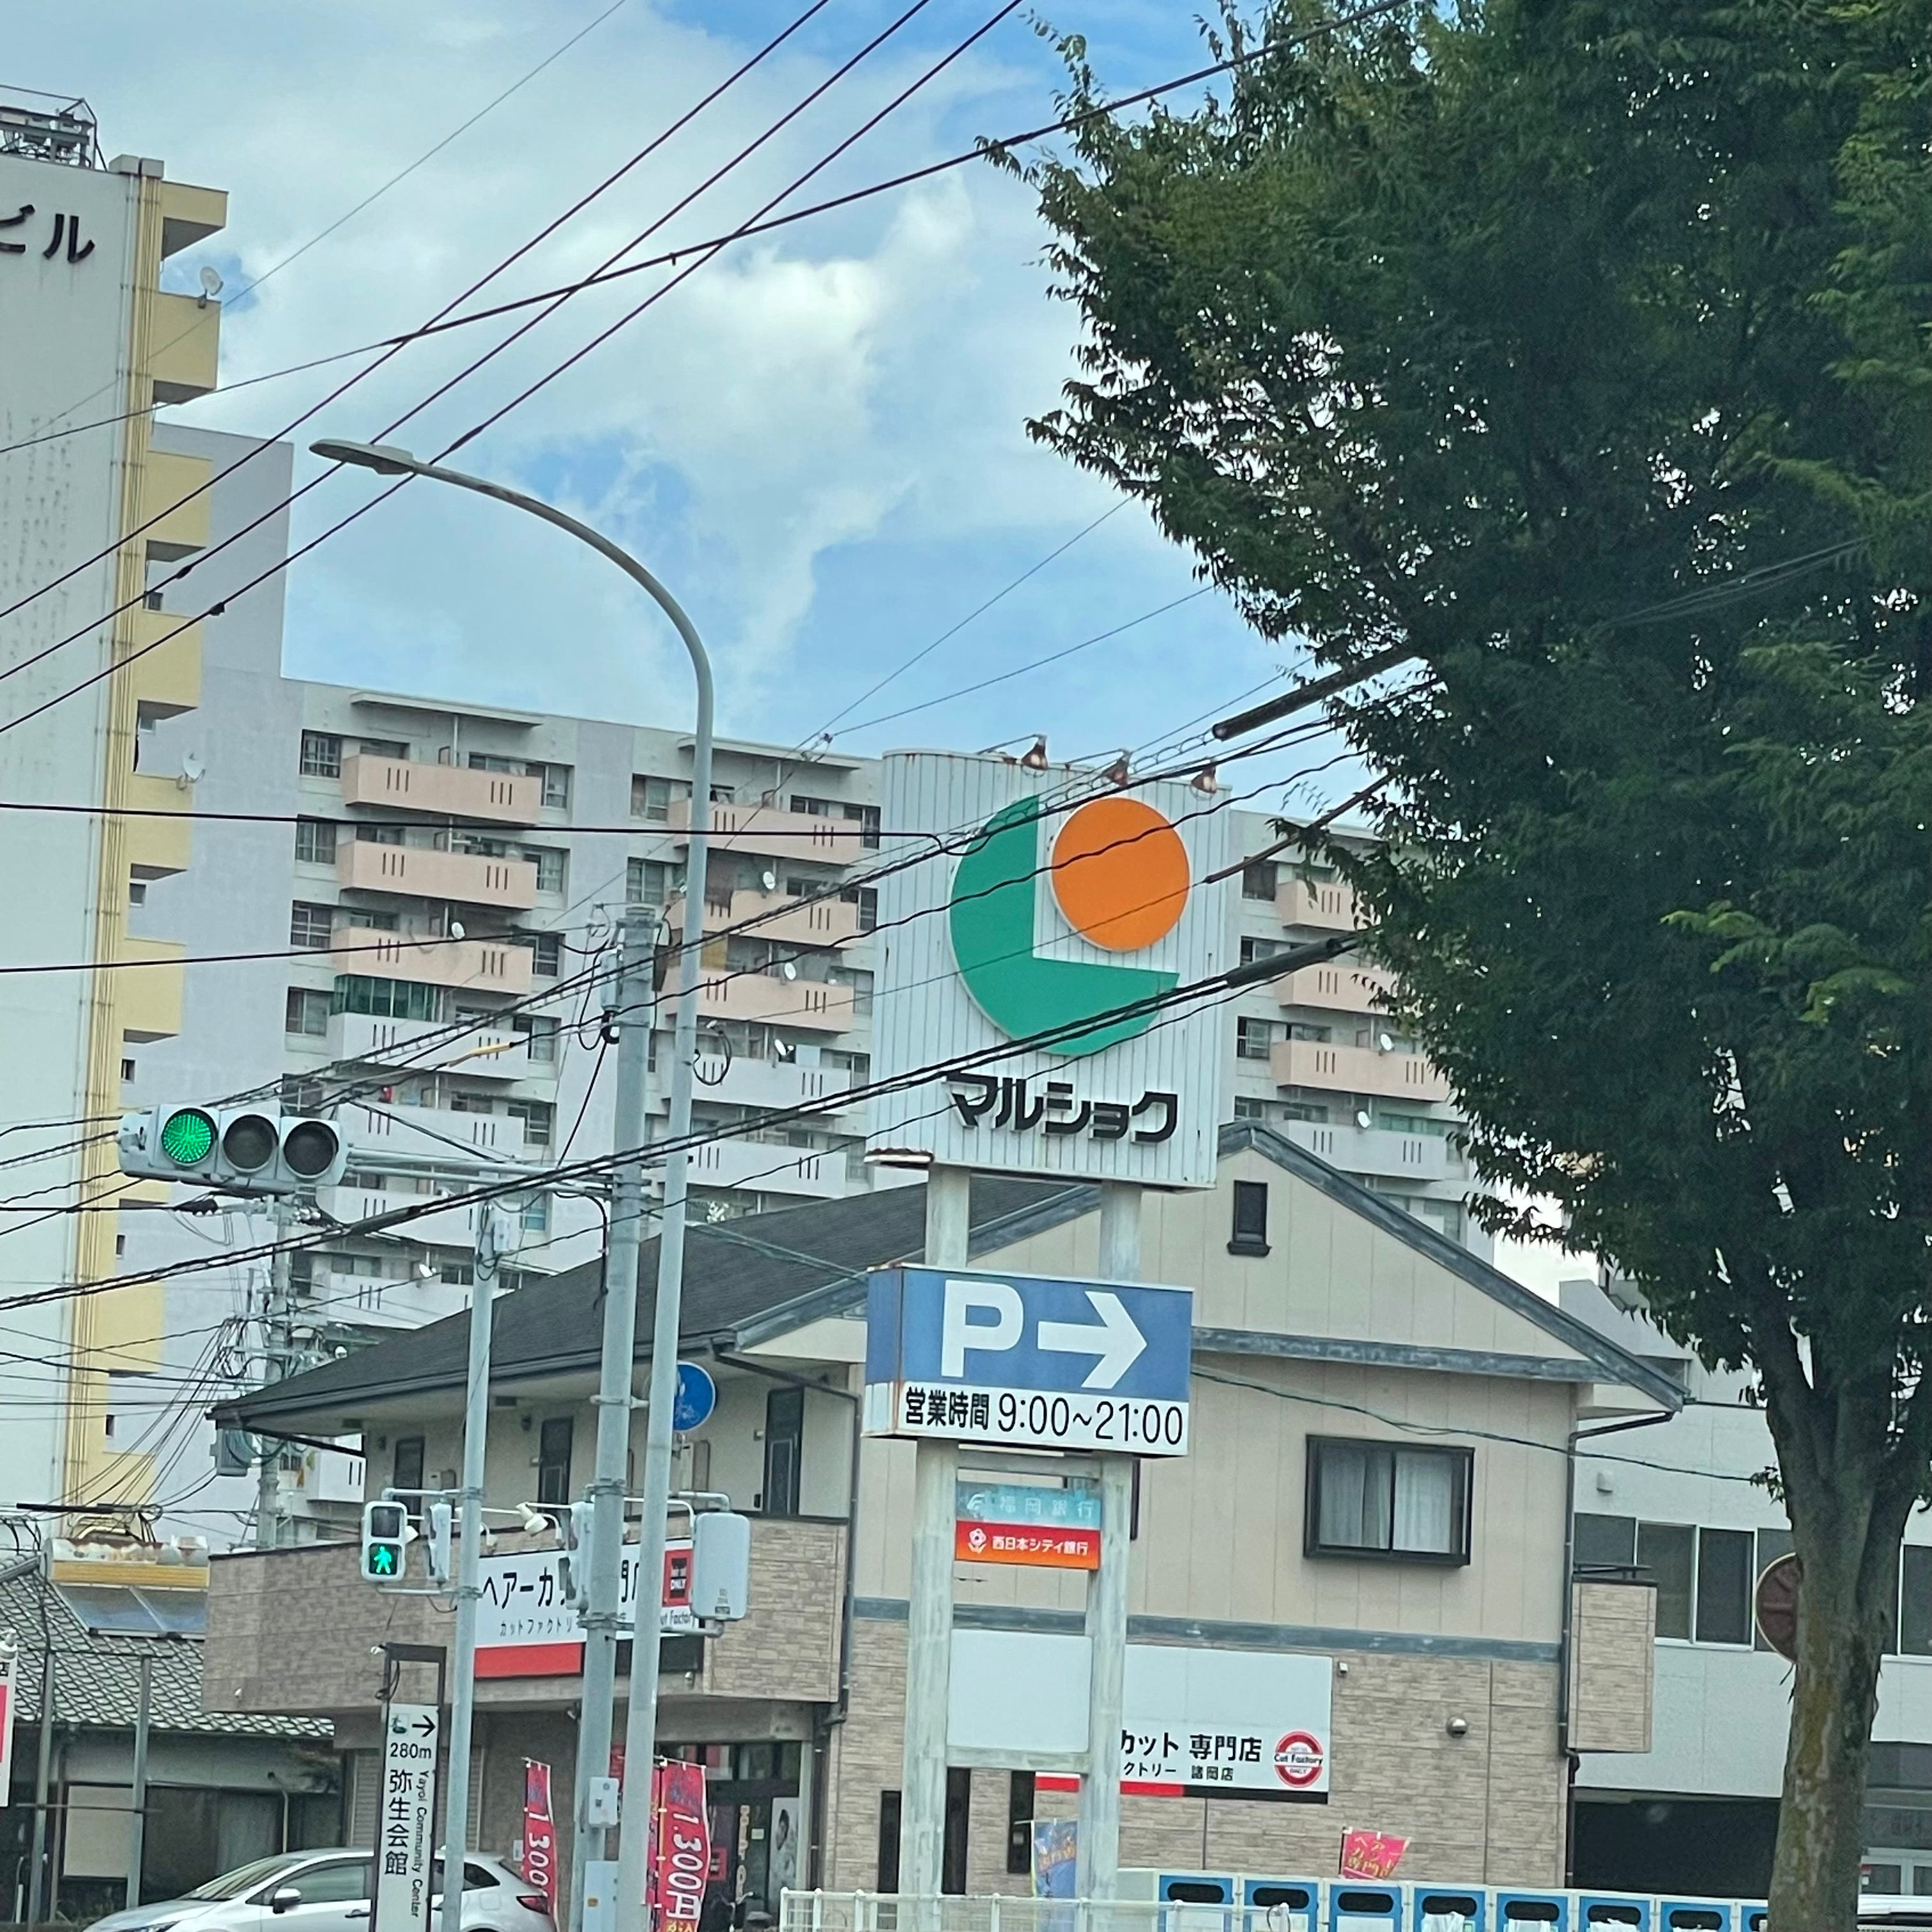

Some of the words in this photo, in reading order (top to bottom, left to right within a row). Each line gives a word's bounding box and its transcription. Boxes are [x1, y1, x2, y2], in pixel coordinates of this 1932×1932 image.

[946, 1072, 1178, 1144] マルショク
[941, 1279, 1023, 1378] P
[905, 1386, 990, 1430] 営業時間
[992, 1535, 1089, 1556] 西日本シティ銀行
[483, 1567, 565, 1609] ヘアーカ
[390, 1742, 432, 1759] 280m
[1189, 1734, 1262, 1762] 専門店
[1124, 1762, 1177, 1777] クトリー
[385, 1769, 413, 1876] 弥生会館
[411, 1806, 427, 1873] Community
[411, 1878, 423, 1918] Center
